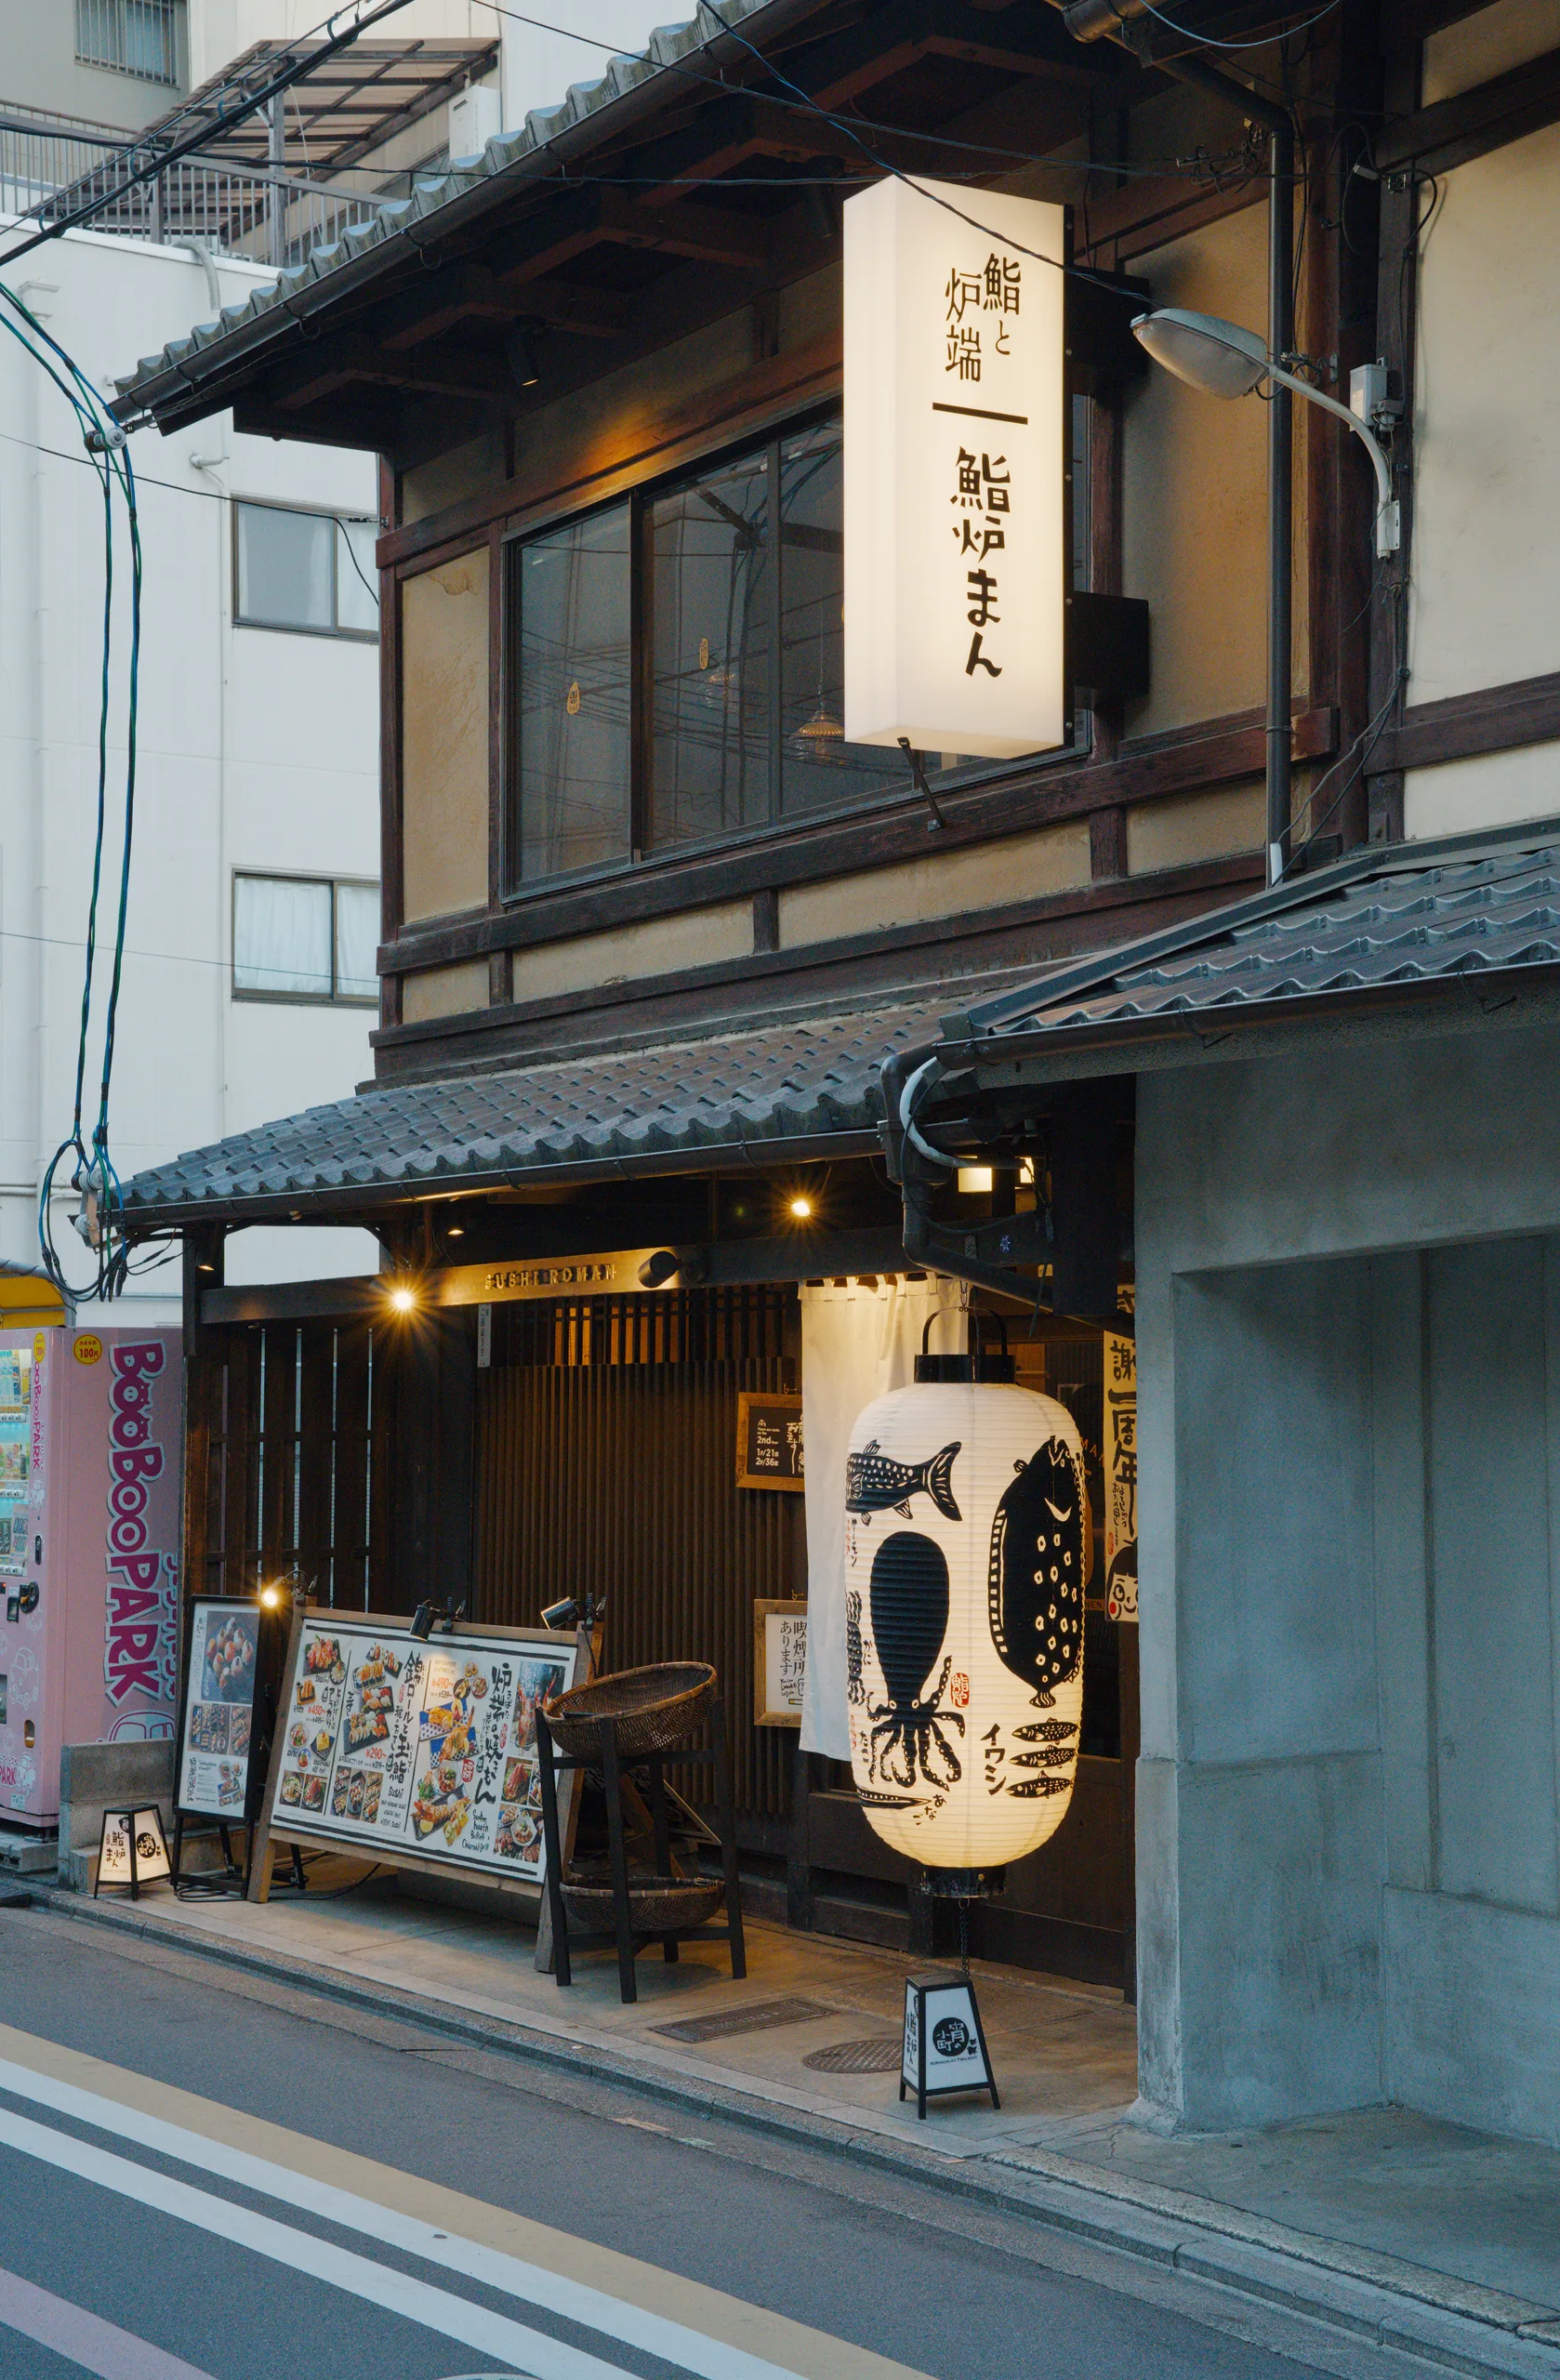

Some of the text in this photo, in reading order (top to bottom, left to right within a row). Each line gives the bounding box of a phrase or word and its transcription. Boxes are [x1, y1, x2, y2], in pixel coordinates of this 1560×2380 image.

[945, 267, 982, 383] 炉端
[983, 252, 1022, 356] 鮨と
[950, 446, 1011, 679] 鮨炉まん
[484, 1264, 617, 1290] SUSHI ROMAN
[757, 1435, 772, 1445] 2nd
[780, 1620, 792, 1676] あります
[980, 1723, 1006, 1796] イワシ
[913, 1793, 946, 1826] あなご
[935, 2030, 952, 2052] 小町
